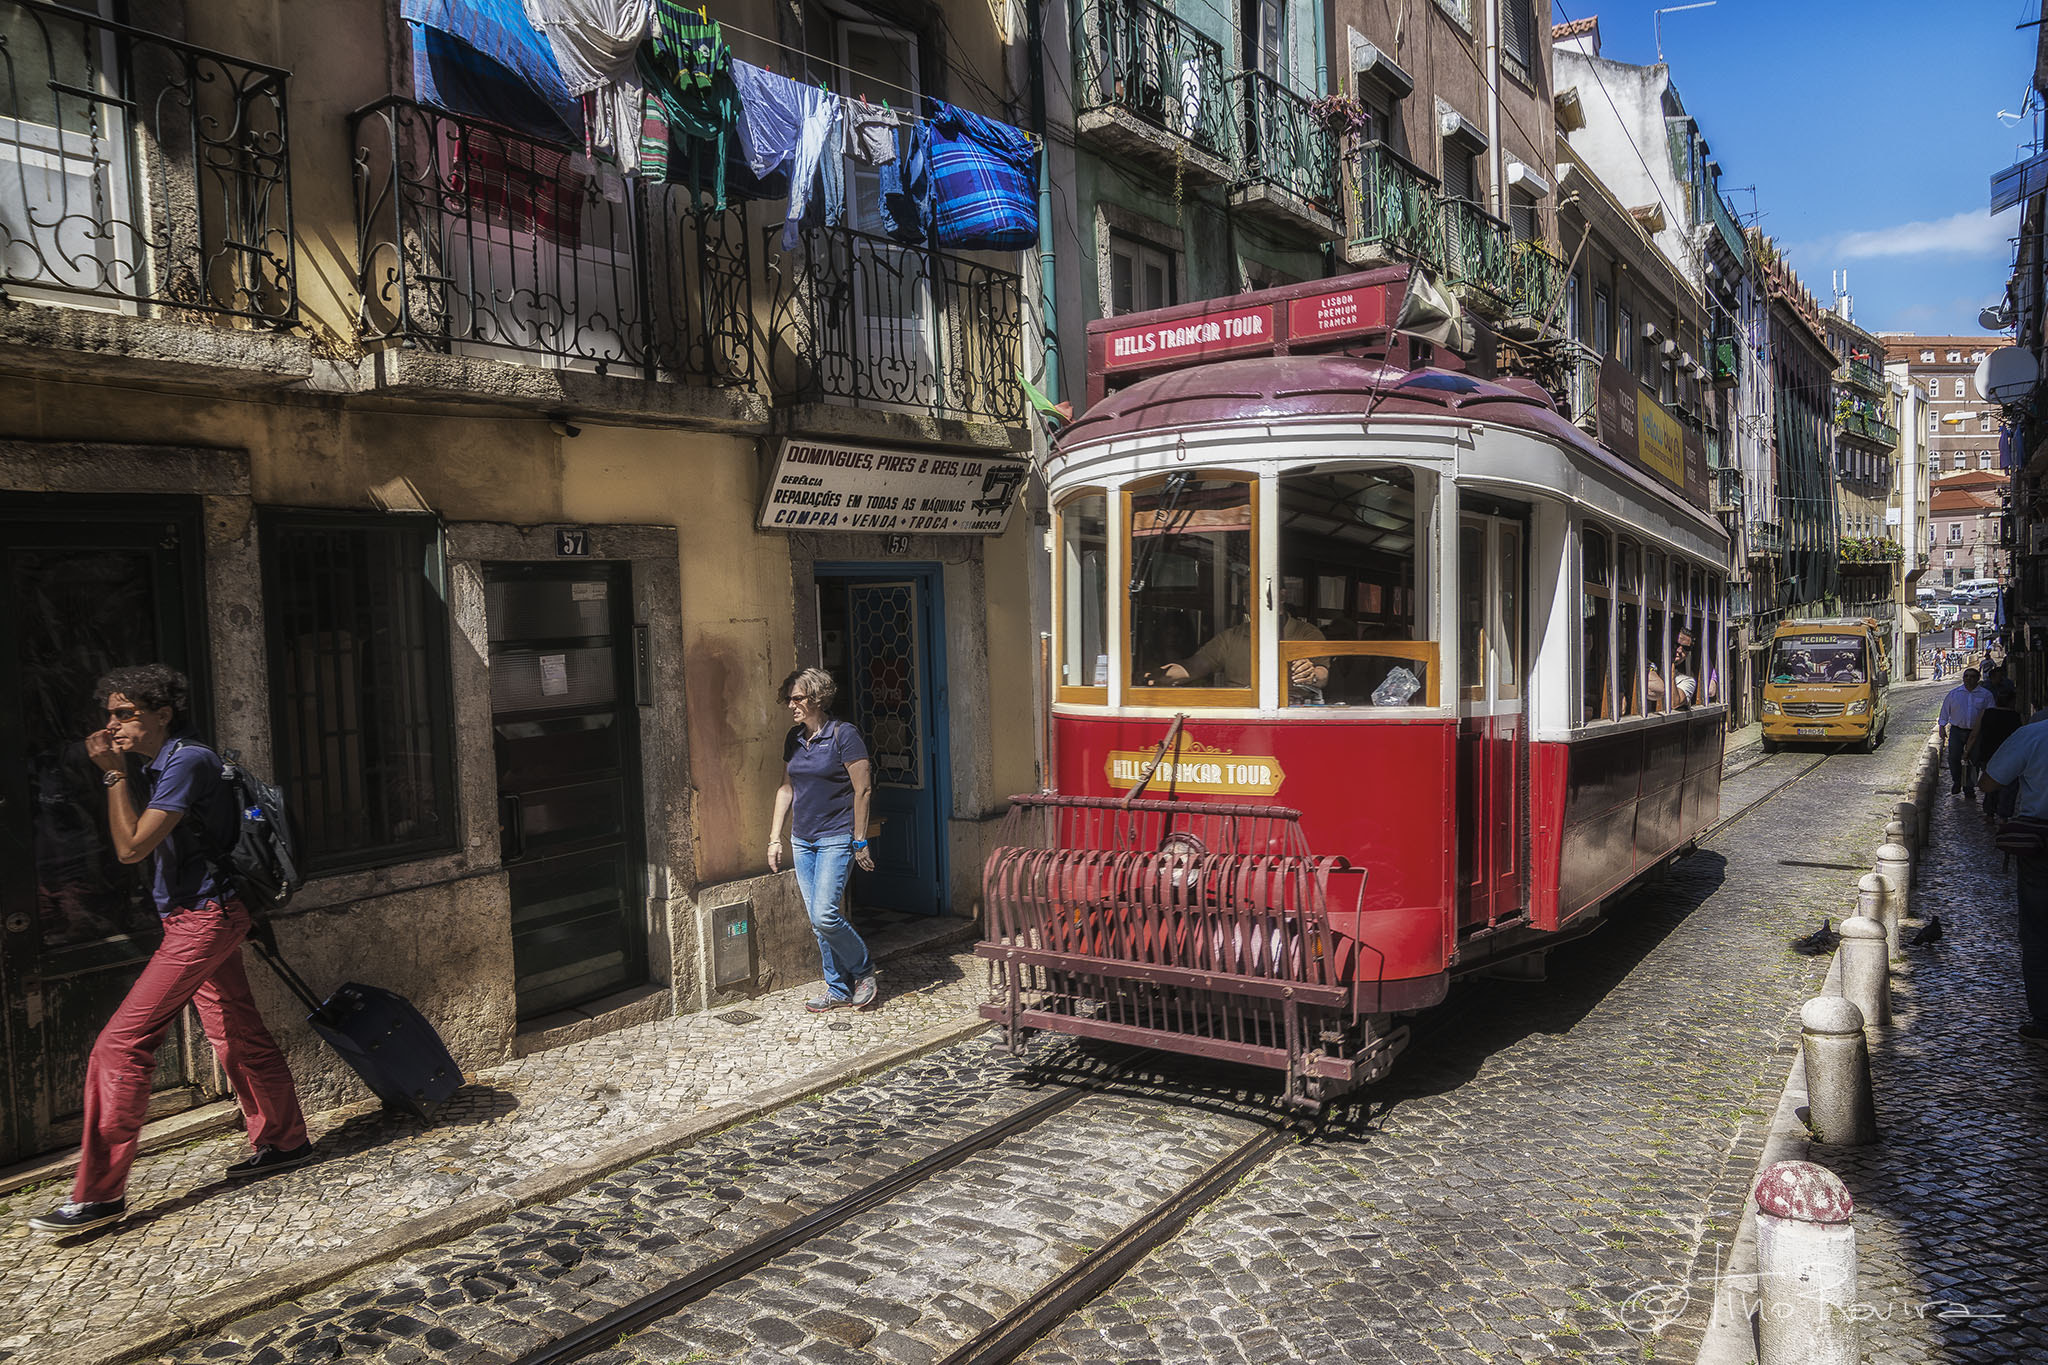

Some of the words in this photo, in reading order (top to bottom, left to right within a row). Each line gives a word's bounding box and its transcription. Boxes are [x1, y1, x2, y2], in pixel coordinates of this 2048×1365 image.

[1321, 294, 1353, 308] LISBON
[1318, 304, 1357, 319] PREMIUM
[1318, 314, 1358, 329] TRAMCAR
[1114, 332, 1157, 357] HILLS
[1158, 321, 1221, 349] TRAMCAR
[1223, 314, 1263, 339] TOUR
[786, 445, 874, 471] DOMINGUES,
[876, 454, 917, 473] PIRES
[918, 459, 929, 473] &
[930, 460, 959, 478] REIS,
[846, 494, 863, 508] EM
[866, 495, 899, 510] TODAS
[901, 497, 917, 511] AS
[919, 497, 966, 514] MÁQUINAS
[774, 509, 839, 527] COMPRA
[852, 513, 898, 529] VENDA
[908, 516, 949, 529] TROCA
[563, 531, 584, 555] 57
[890, 536, 908, 554] 59
[1226, 764, 1273, 785] TOUR
